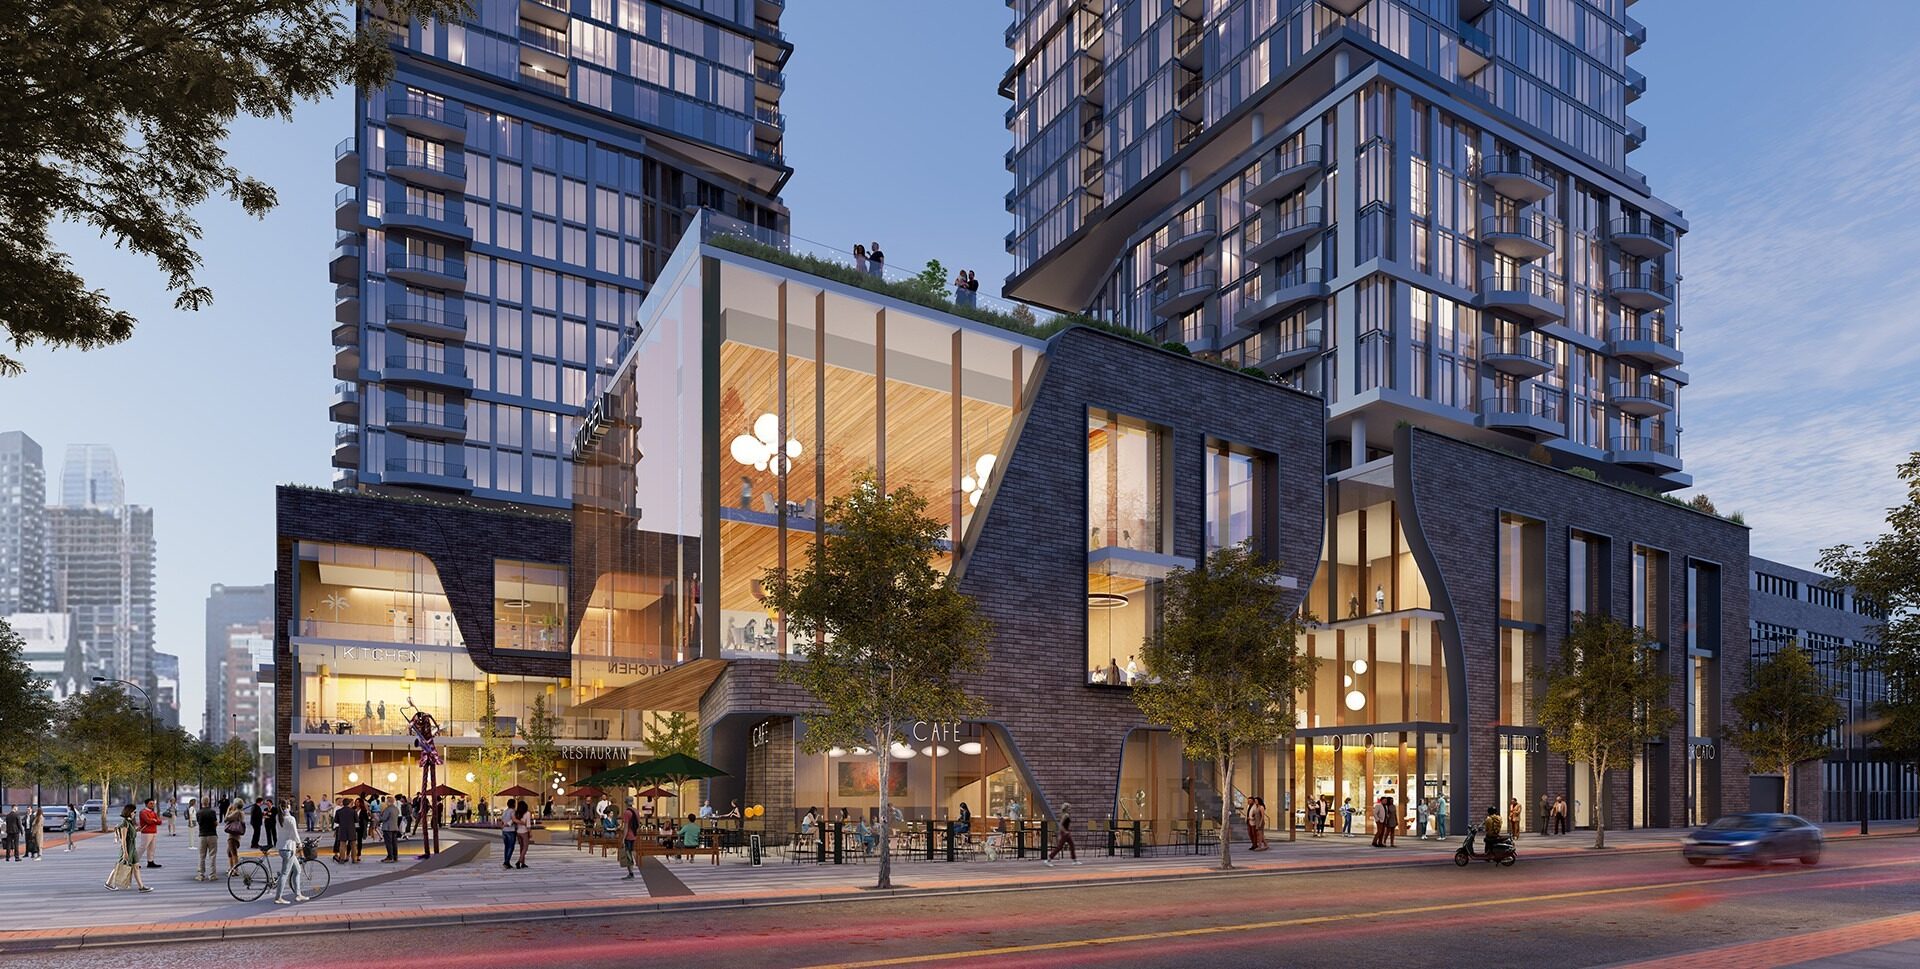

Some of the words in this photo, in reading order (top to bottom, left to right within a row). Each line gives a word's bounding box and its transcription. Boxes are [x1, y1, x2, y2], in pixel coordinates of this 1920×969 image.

[343, 647, 421, 662] KITCHEN
[1323, 732, 1389, 752] BOUTIQUE
[561, 745, 634, 760] RESTAURANT
